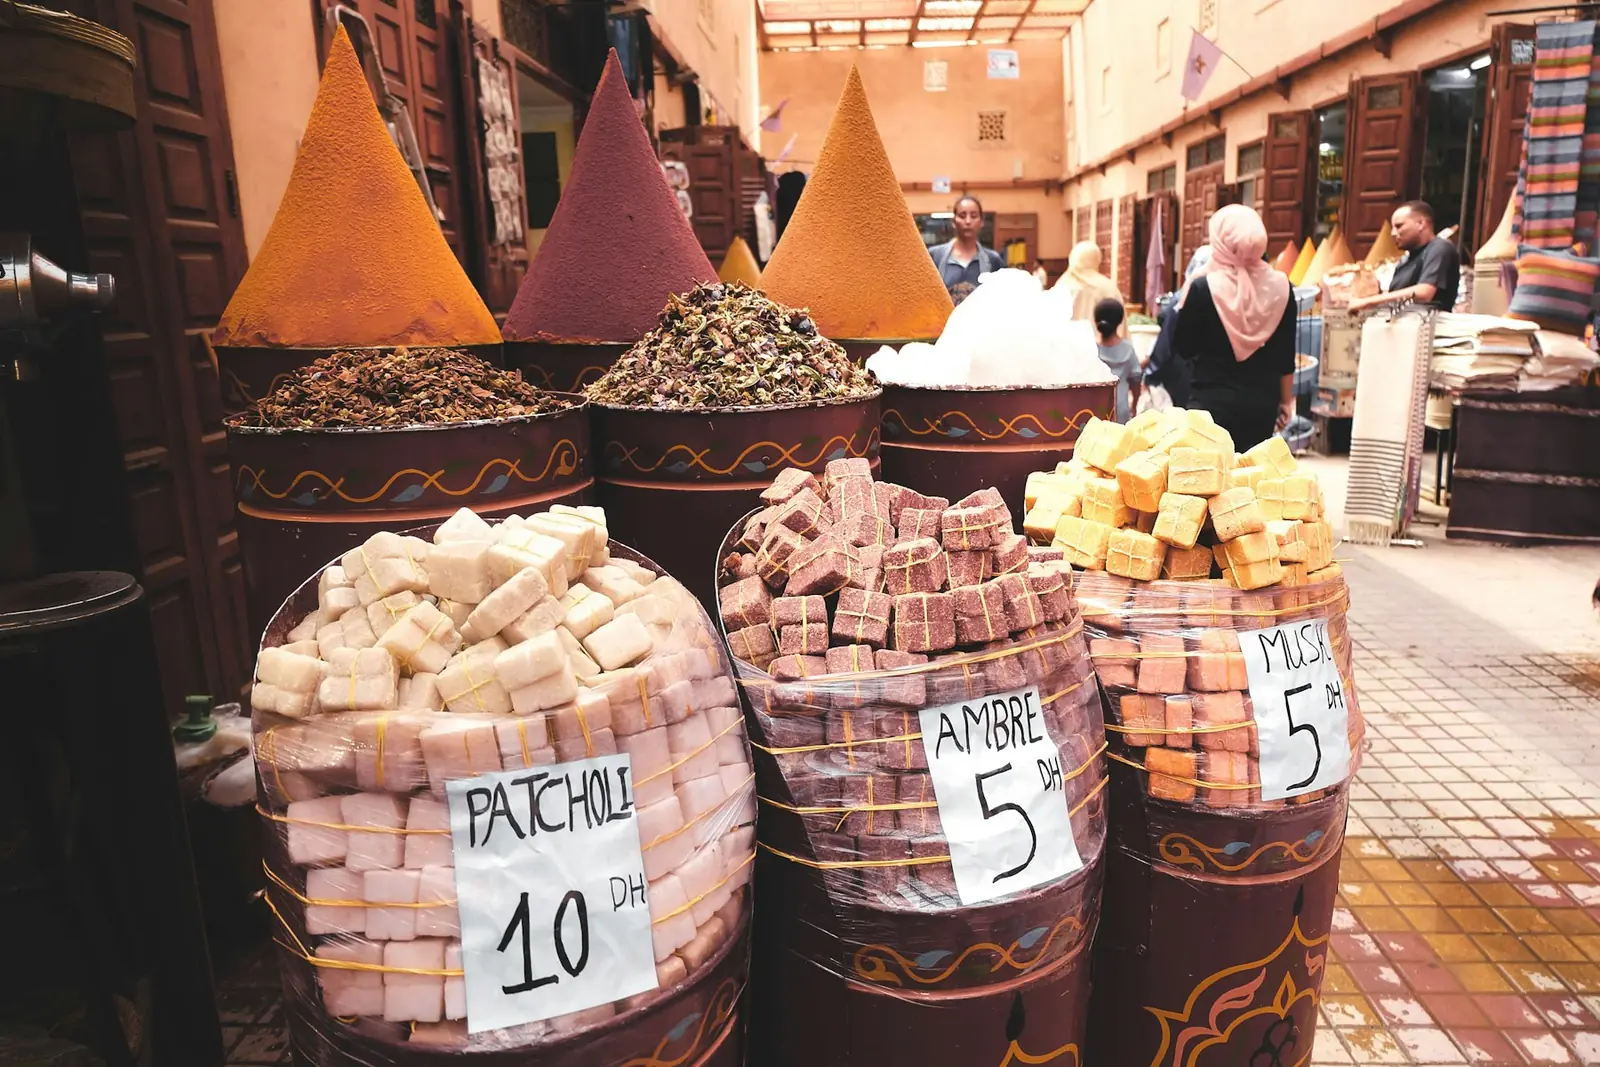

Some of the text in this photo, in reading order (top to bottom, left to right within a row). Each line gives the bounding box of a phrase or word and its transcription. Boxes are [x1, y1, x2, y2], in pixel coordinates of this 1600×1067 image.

[1258, 623, 1332, 673] MUSK
[935, 691, 1044, 760] AMBRE
[1284, 680, 1344, 791] 5 DH
[466, 766, 634, 848] PATCHOLI
[975, 756, 1063, 884] 5 DH
[496, 872, 646, 995] 10 DH
